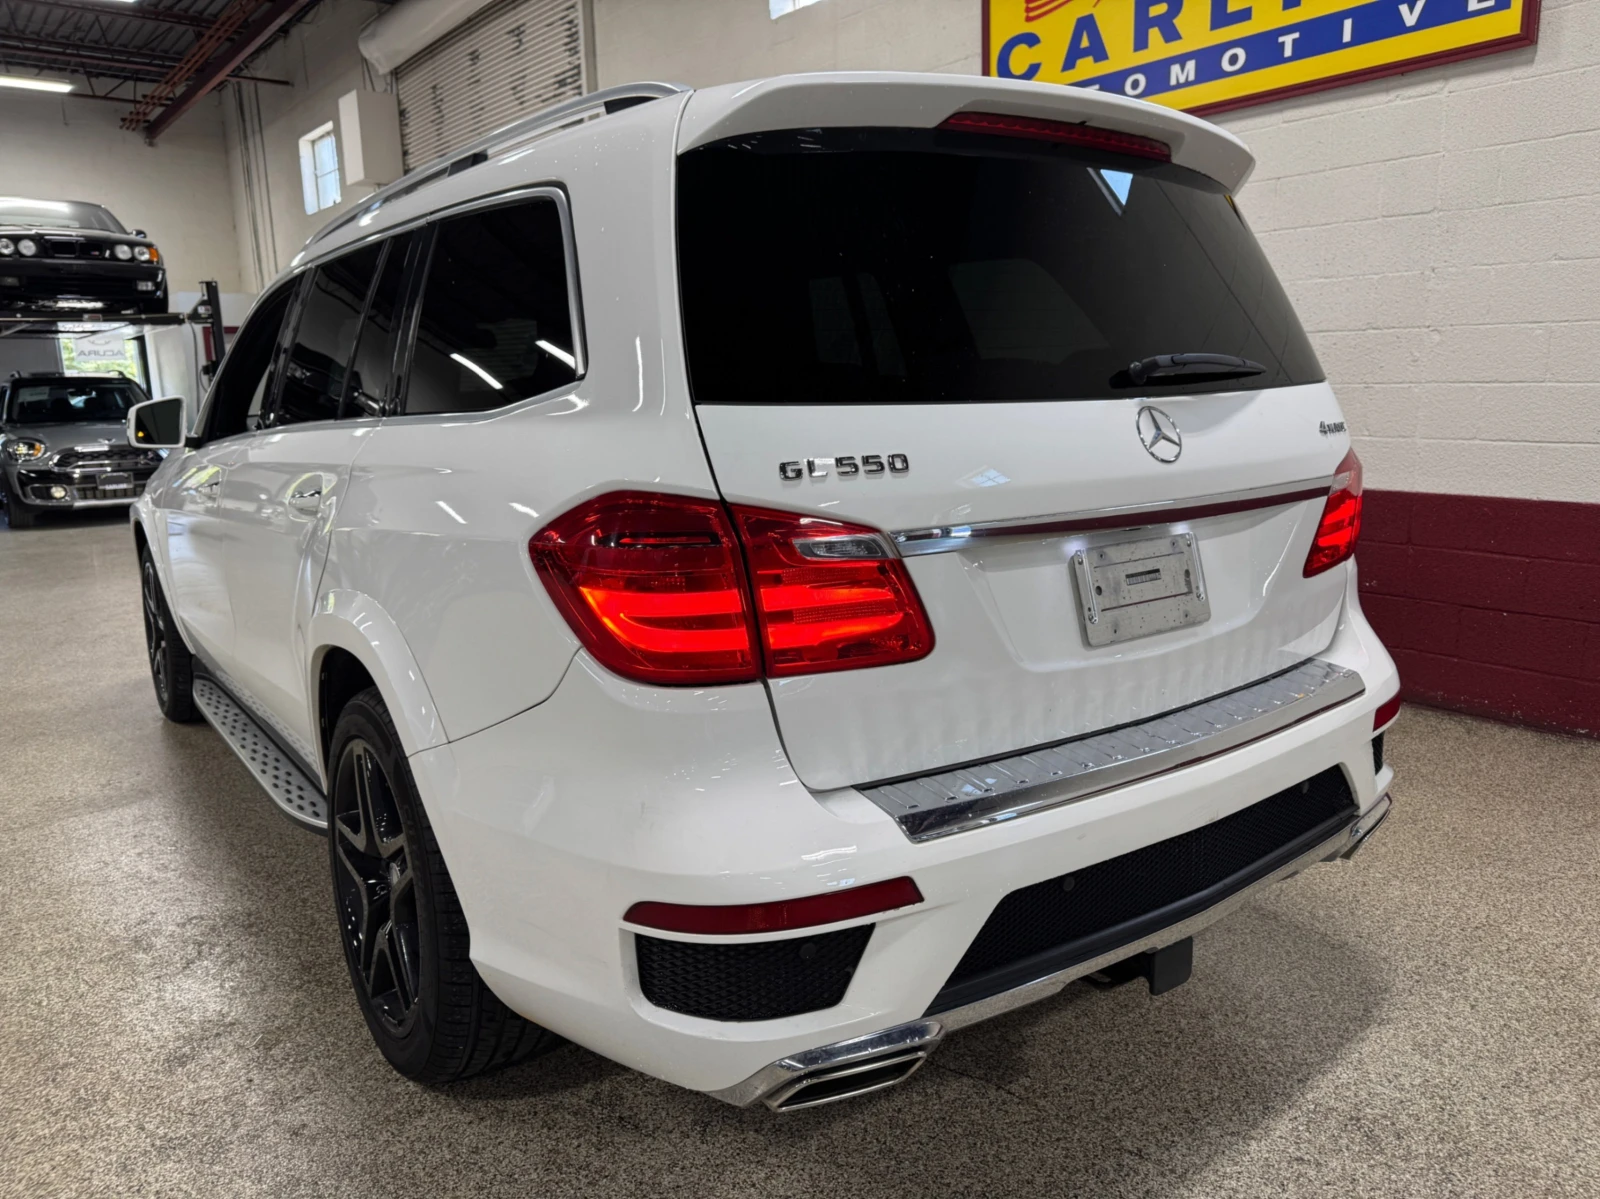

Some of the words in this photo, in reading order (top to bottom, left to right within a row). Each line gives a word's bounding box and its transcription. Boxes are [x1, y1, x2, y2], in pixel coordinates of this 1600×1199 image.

[996, 0, 1302, 81] CARL
[779, 459, 828, 481] GL
[834, 453, 909, 477] 550
